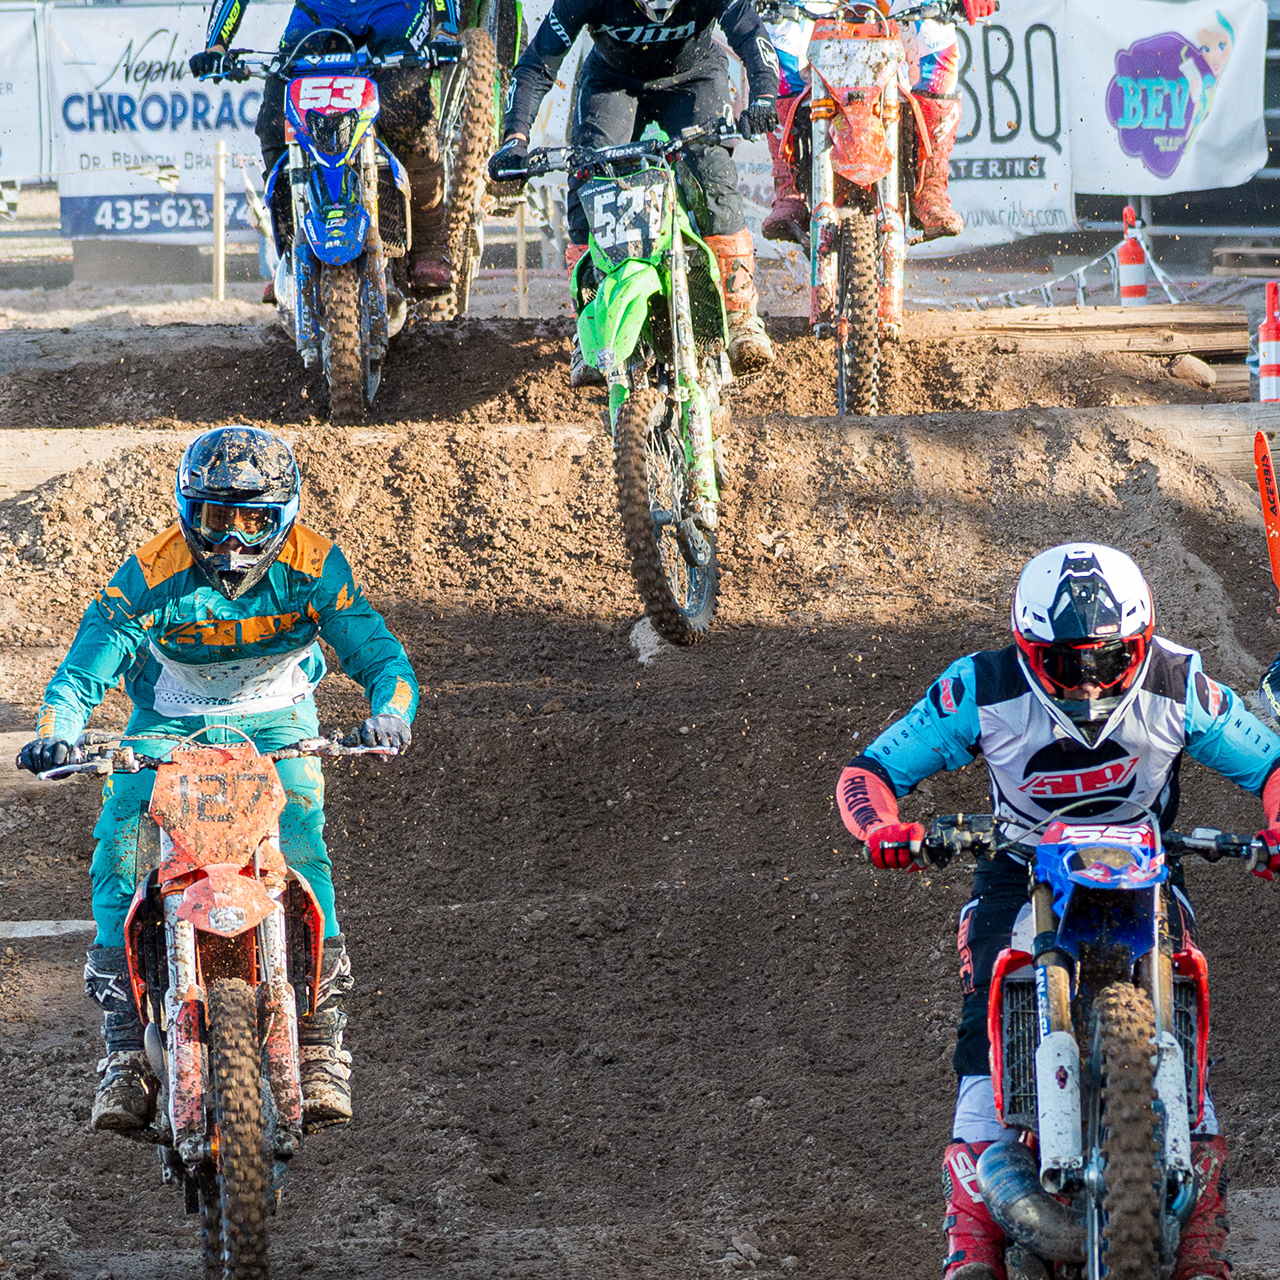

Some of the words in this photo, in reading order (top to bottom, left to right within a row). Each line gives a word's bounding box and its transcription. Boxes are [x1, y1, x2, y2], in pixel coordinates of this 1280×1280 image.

[96, 28, 191, 100] Nephi
[62, 91, 263, 133] CHIROPRAC
[299, 77, 366, 110] 53
[949, 158, 1041, 179] ATERING
[580, 182, 618, 198] JOHNSON
[94, 199, 250, 230] 435-62374
[593, 184, 665, 250] 521
[1261, 454, 1278, 517] ACERBIS
[180, 773, 269, 822] 127
[1061, 825, 1148, 844] 55
